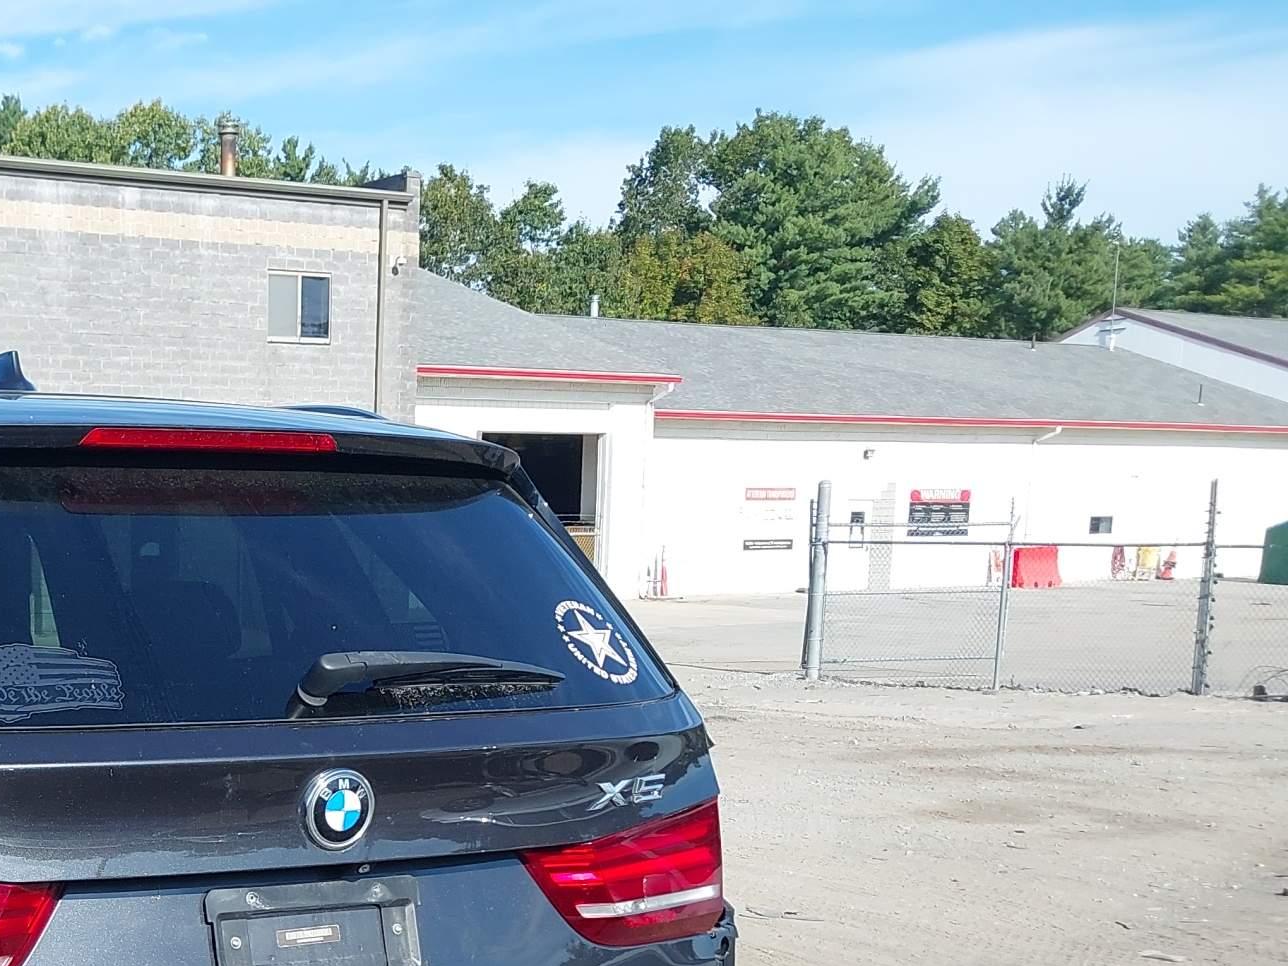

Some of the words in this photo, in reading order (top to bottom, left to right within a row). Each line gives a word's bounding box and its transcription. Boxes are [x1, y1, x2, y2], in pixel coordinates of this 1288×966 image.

[920, 489, 961, 500] WARNING
[568, 643, 609, 680] UNITED
[21, 686, 53, 702] the
[55, 683, 121, 704] People
[319, 778, 367, 801] BMW
[586, 773, 666, 812] X5
